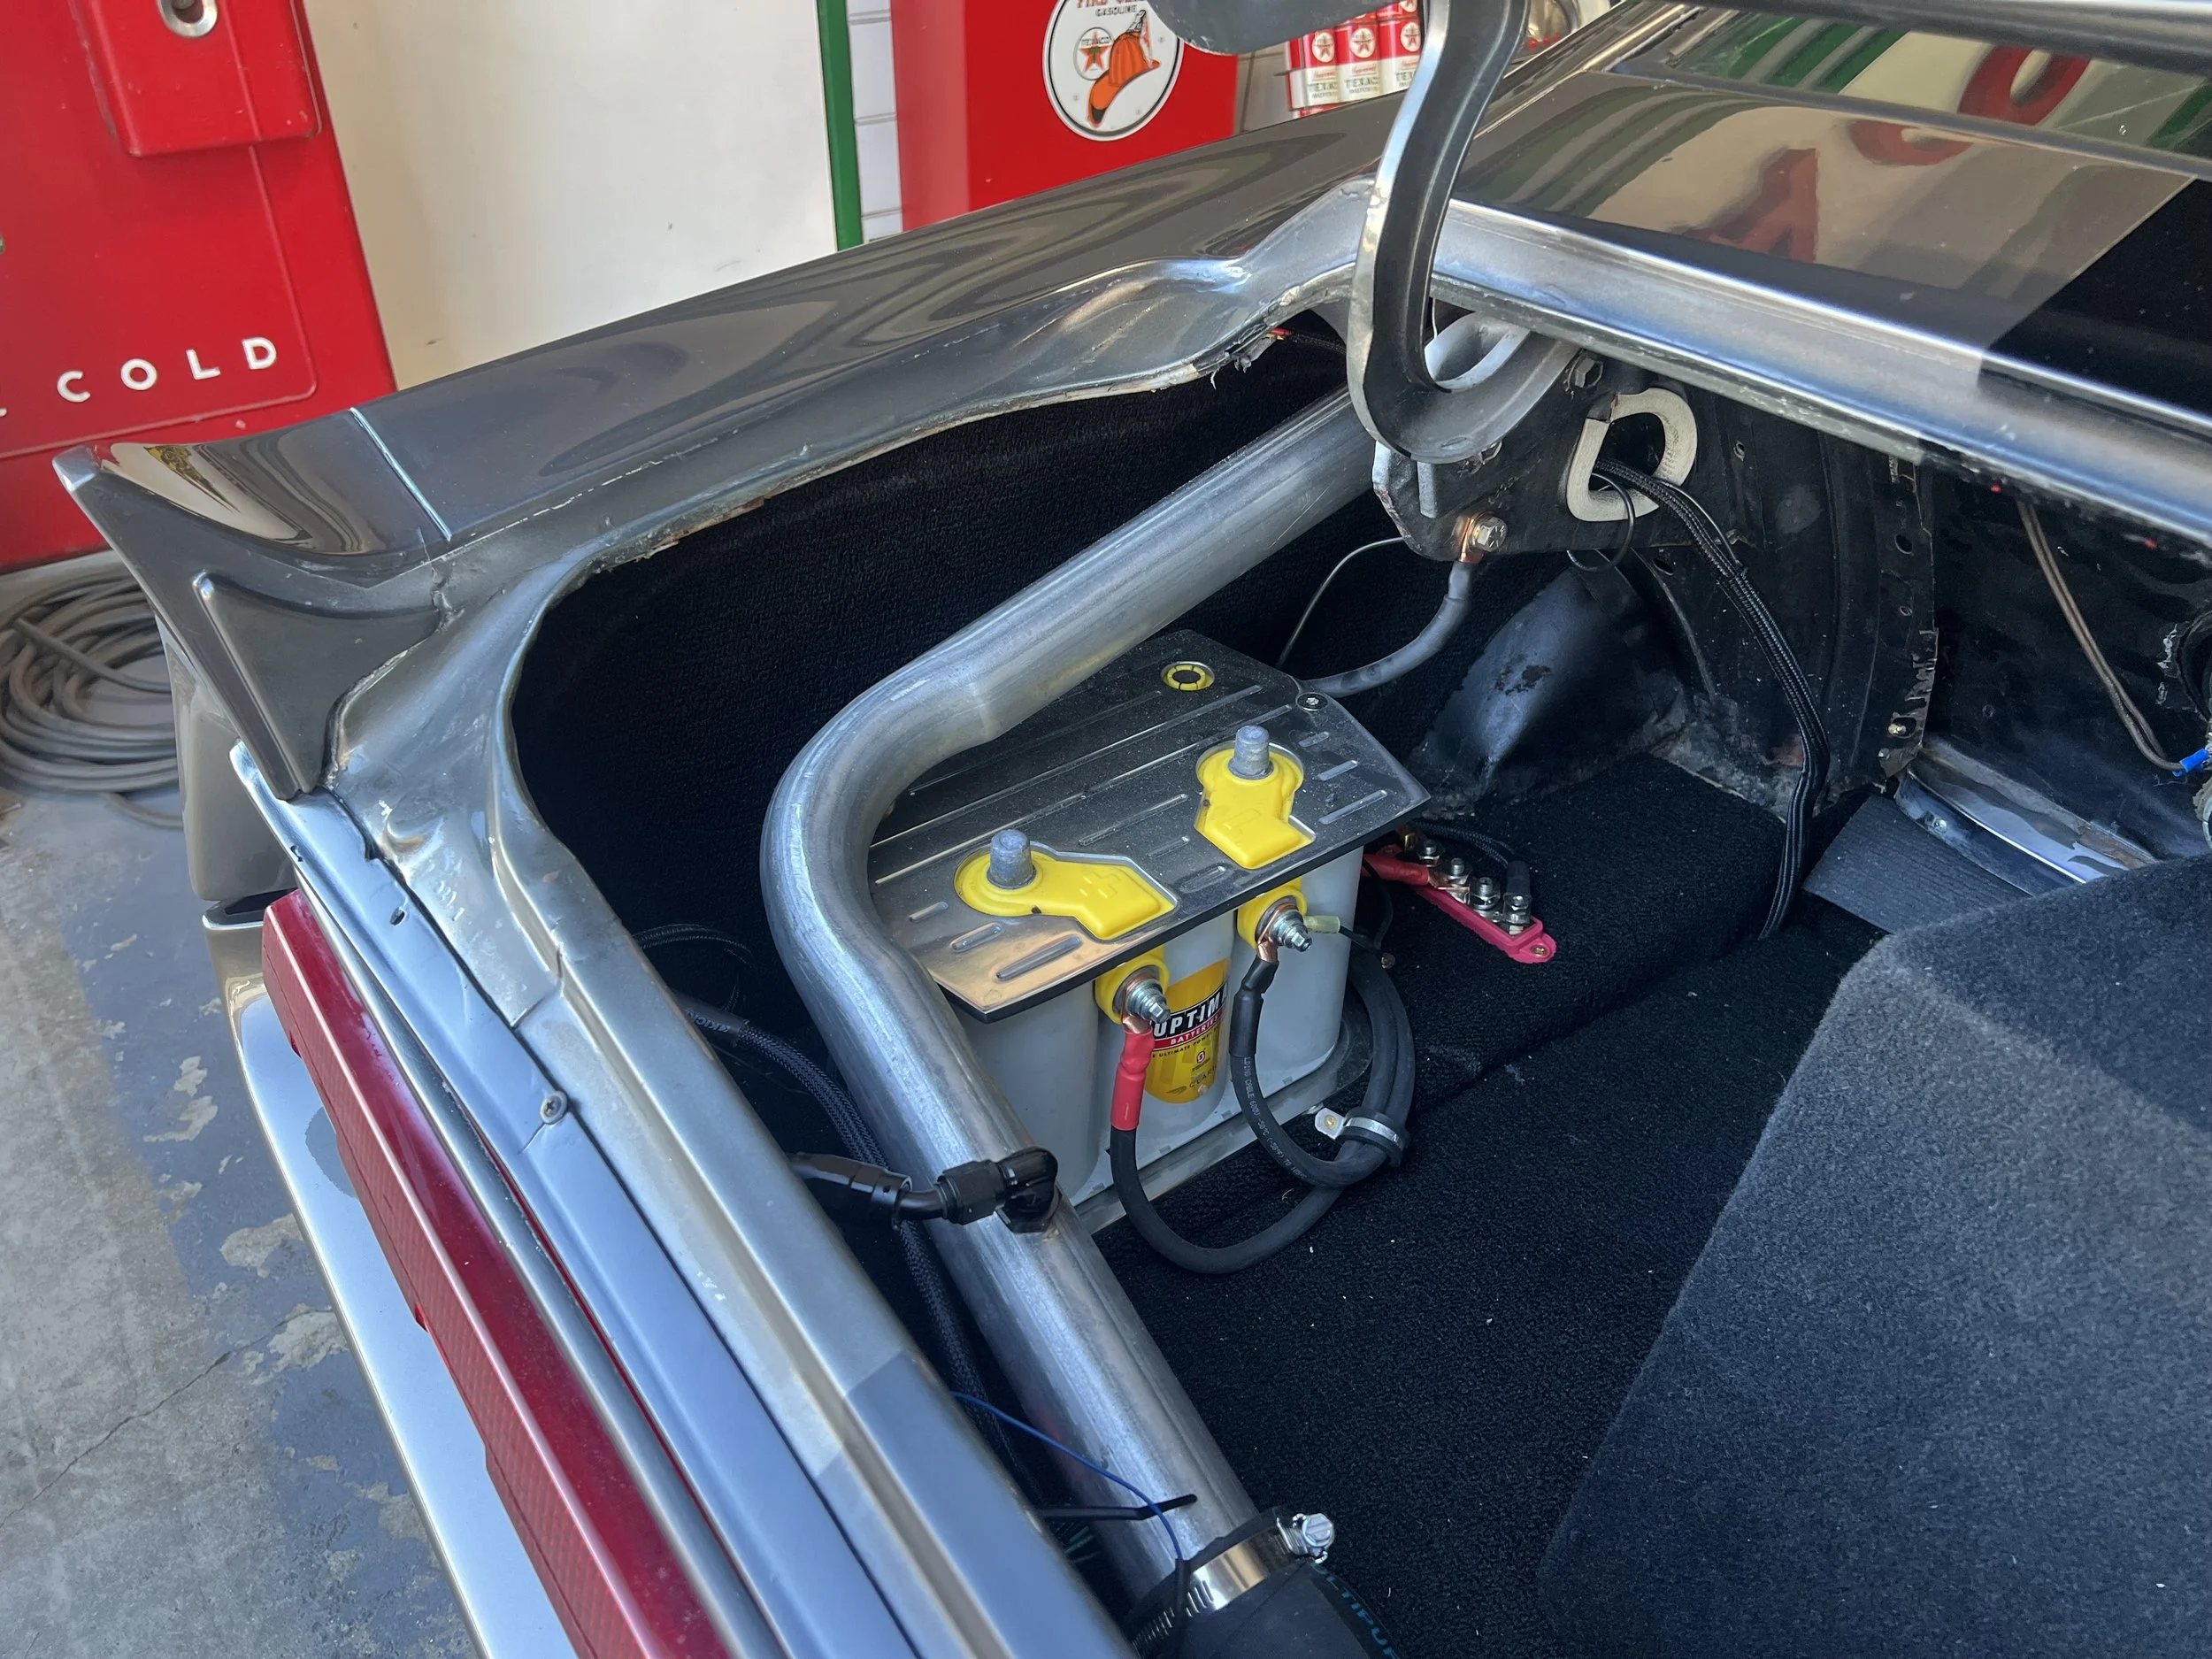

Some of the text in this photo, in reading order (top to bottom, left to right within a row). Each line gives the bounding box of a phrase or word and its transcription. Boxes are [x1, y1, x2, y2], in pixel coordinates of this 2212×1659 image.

[57, 336, 277, 403] COLD
[1171, 1015, 1219, 1045] BATTERIES
[1159, 1045, 1191, 1057] ULTIMATE
[1244, 1079, 1256, 1099] CABLE
